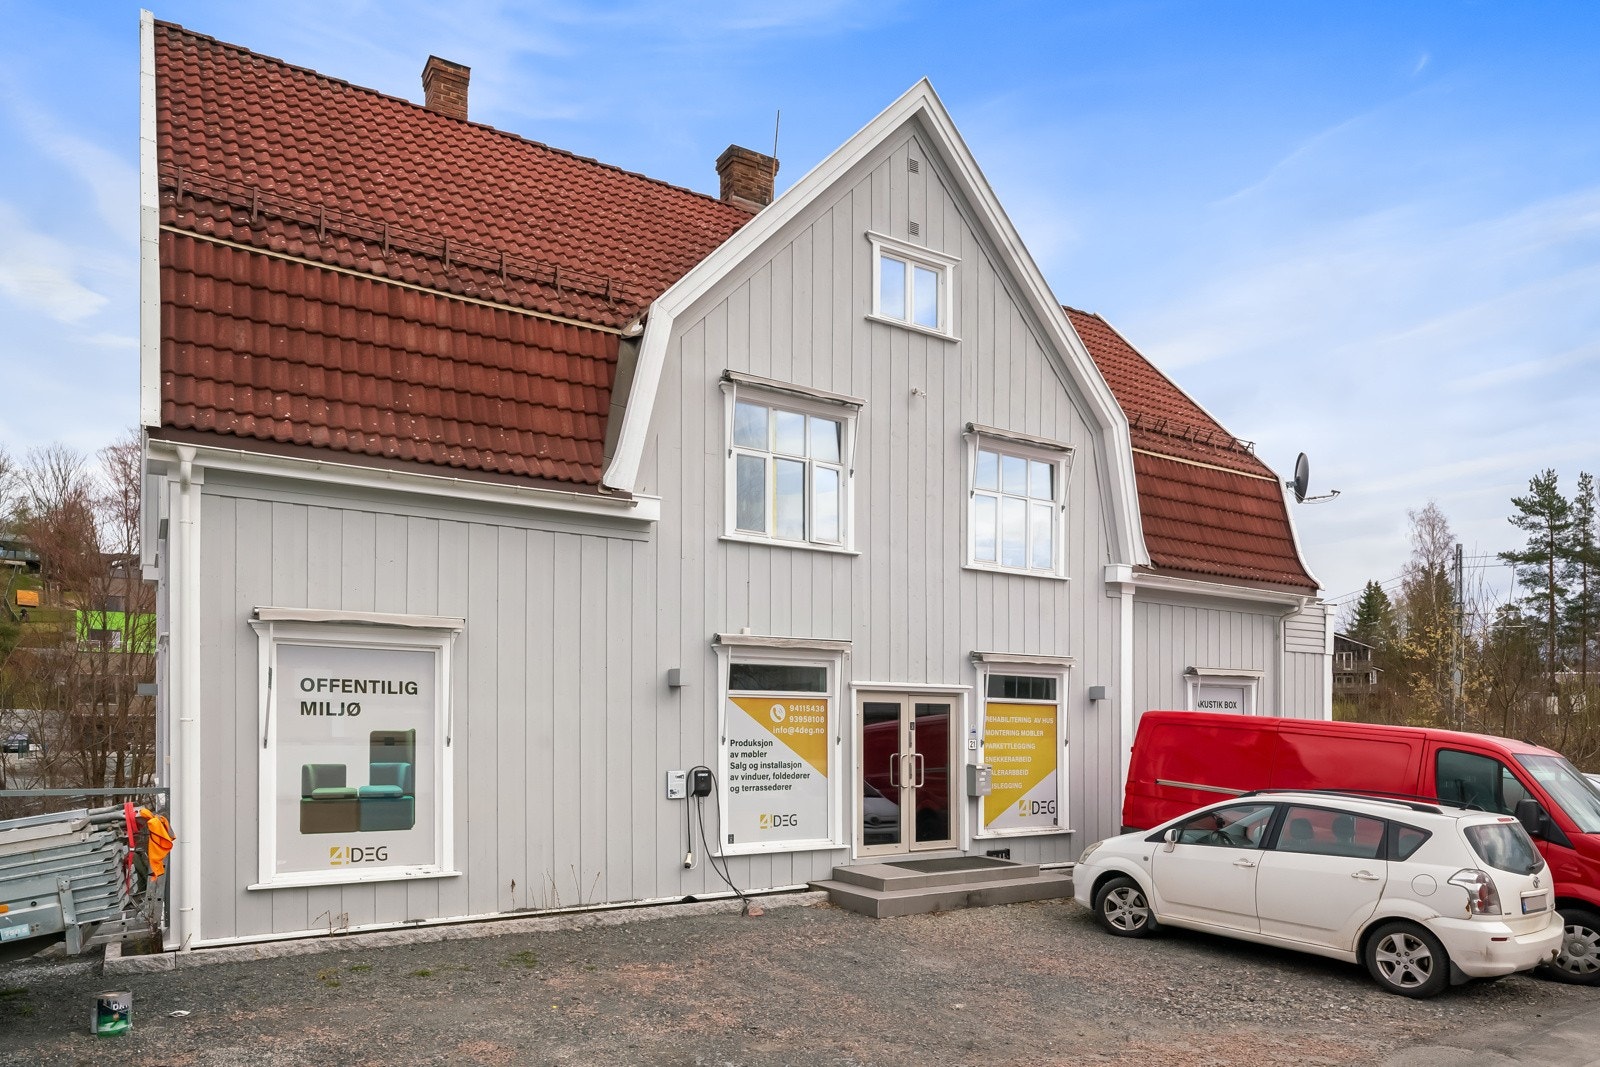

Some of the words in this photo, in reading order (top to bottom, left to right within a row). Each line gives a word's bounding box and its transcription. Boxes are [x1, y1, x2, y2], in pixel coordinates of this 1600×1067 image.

[300, 678, 418, 695] OFFENTILIG
[300, 701, 361, 716] MILJØ
[789, 704, 825, 713] 94115438
[1224, 701, 1237, 709] BOX
[772, 726, 825, 735] info@4deg.no
[730, 739, 773, 748] Produksjon
[970, 740, 976, 748] 21
[741, 750, 767, 758] møbler
[730, 762, 747, 771] Salg
[760, 761, 802, 770] installasjon
[772, 772, 810, 780] foldedører
[741, 784, 792, 792] terrassedører
